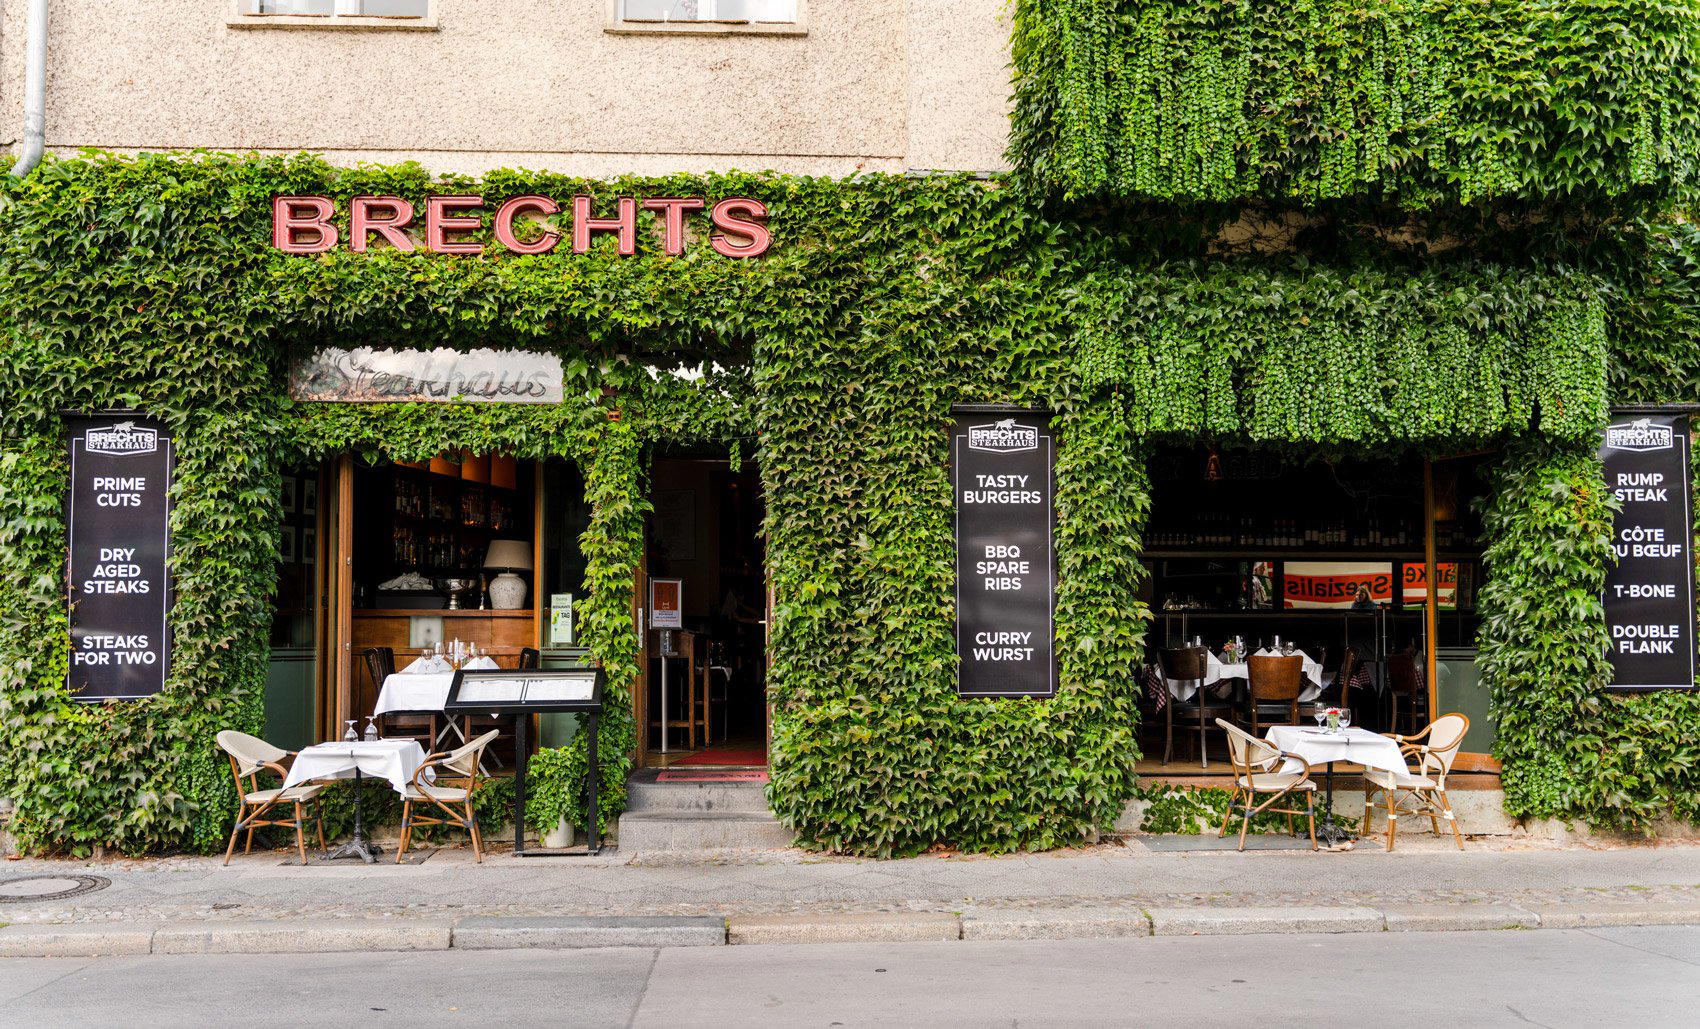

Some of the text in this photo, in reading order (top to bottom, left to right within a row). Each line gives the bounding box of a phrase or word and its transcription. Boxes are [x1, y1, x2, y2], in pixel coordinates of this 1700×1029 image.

[273, 195, 772, 258] BRECHTS
[310, 350, 549, 399] Steakhaus
[89, 432, 154, 443] BRECHTS
[972, 430, 1035, 439] BRECHTS
[1609, 429, 1670, 439] BRECHTS
[971, 439, 1035, 447] STEAKHAUS
[94, 478, 145, 490] PRIME
[976, 475, 1028, 487] TASTY
[1618, 473, 1663, 486] RUMP
[97, 494, 141, 506] CUTS
[964, 491, 1041, 503] BURGERS
[1615, 489, 1667, 501] STEAK
[1621, 526, 1664, 541] CÔTE
[101, 548, 135, 561] DRY
[985, 544, 1020, 558] BBQ
[1633, 544, 1681, 557] BŒUF
[93, 564, 140, 577] AGED
[977, 561, 1029, 574] SPARE
[84, 580, 149, 593] STEAKS
[985, 577, 1022, 590] RIBS
[1614, 585, 1675, 597] T-BONE
[1613, 625, 1679, 638] DOUBLE
[83, 636, 148, 649] STEAKS
[976, 632, 1031, 645] CURRY
[1620, 641, 1673, 653] FLANK
[74, 651, 156, 665] FOR TWO
[973, 648, 1034, 660] WURST
